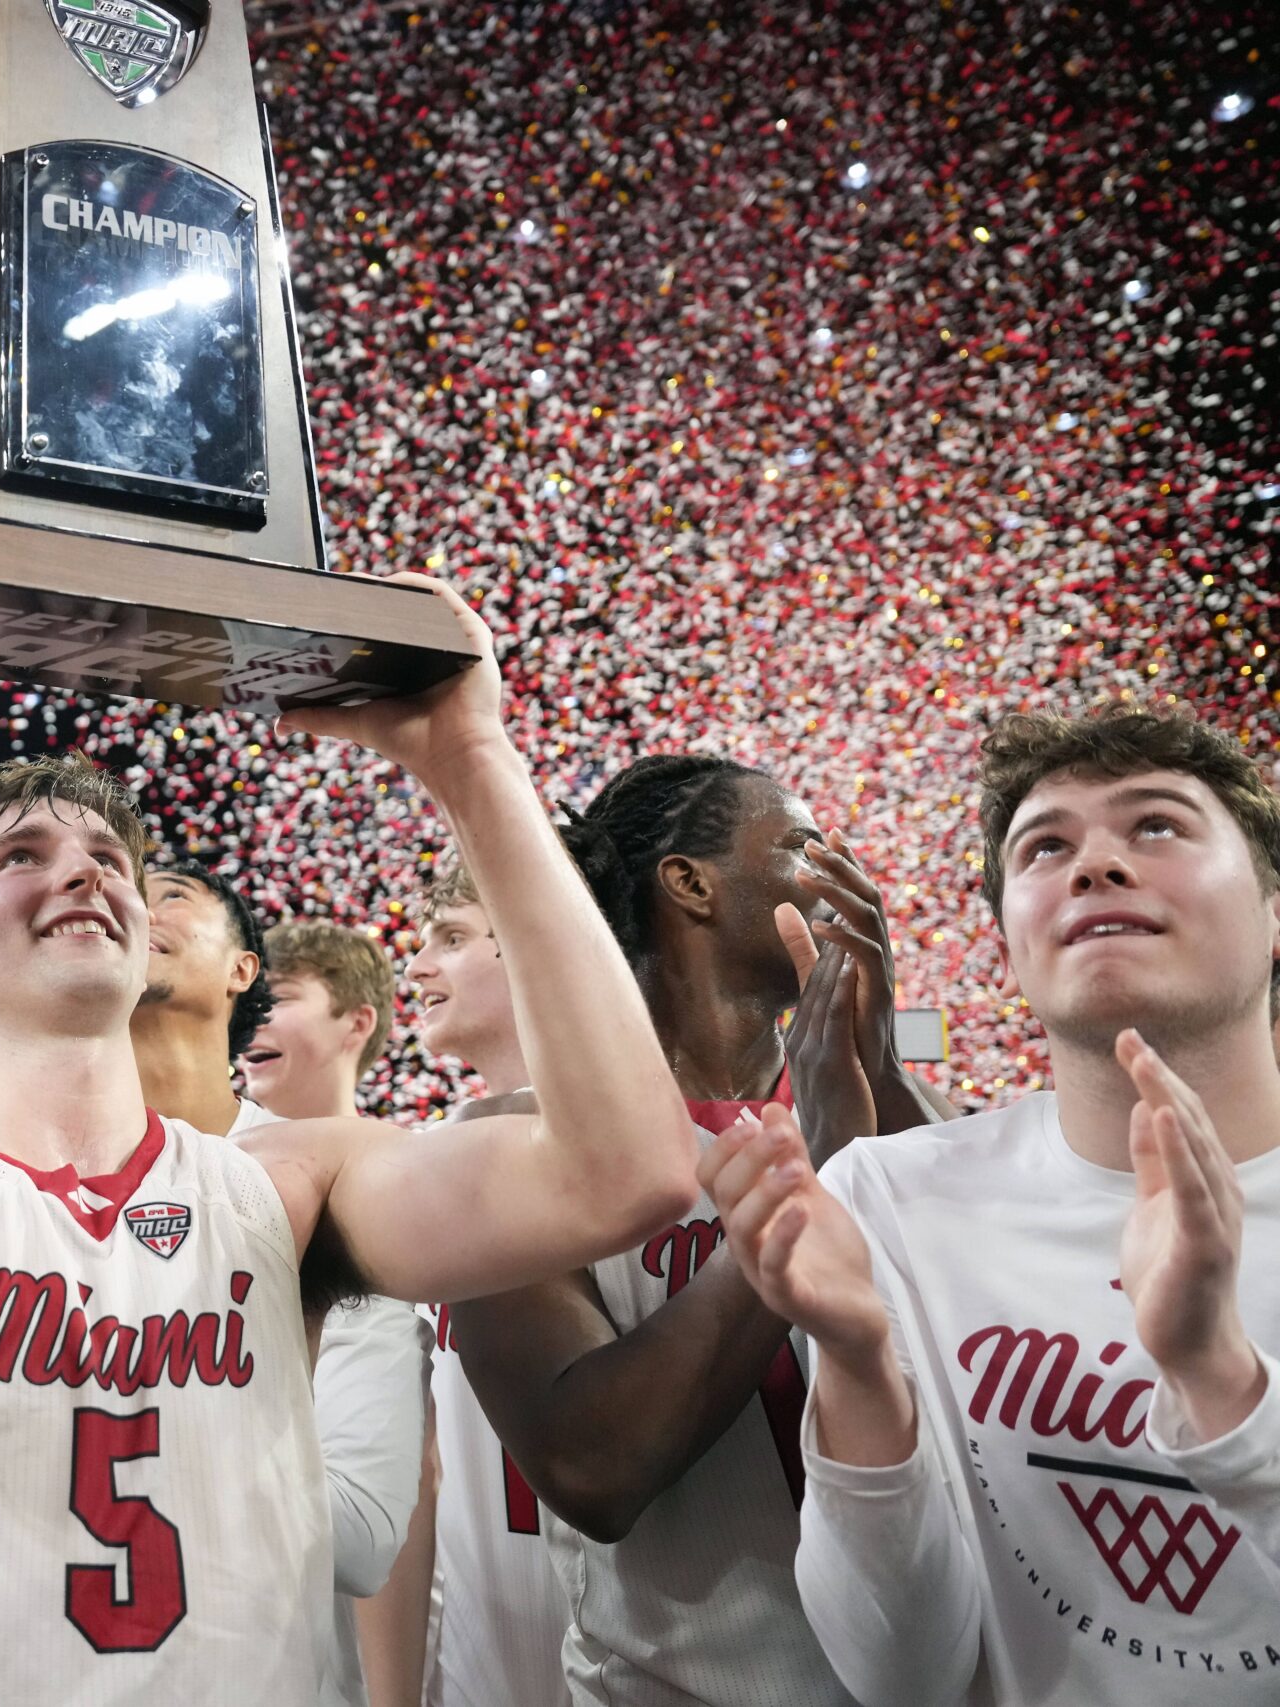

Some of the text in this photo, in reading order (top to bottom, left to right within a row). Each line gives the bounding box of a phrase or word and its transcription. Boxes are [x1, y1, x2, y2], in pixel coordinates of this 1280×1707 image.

[61, 12, 168, 63] MAC
[99, 2, 132, 18] 1946
[41, 193, 241, 270] CHAMPION
[132, 1217, 191, 1237] MAC
[957, 1325, 1156, 1452] Mia
[65, 1406, 187, 1654] 5
